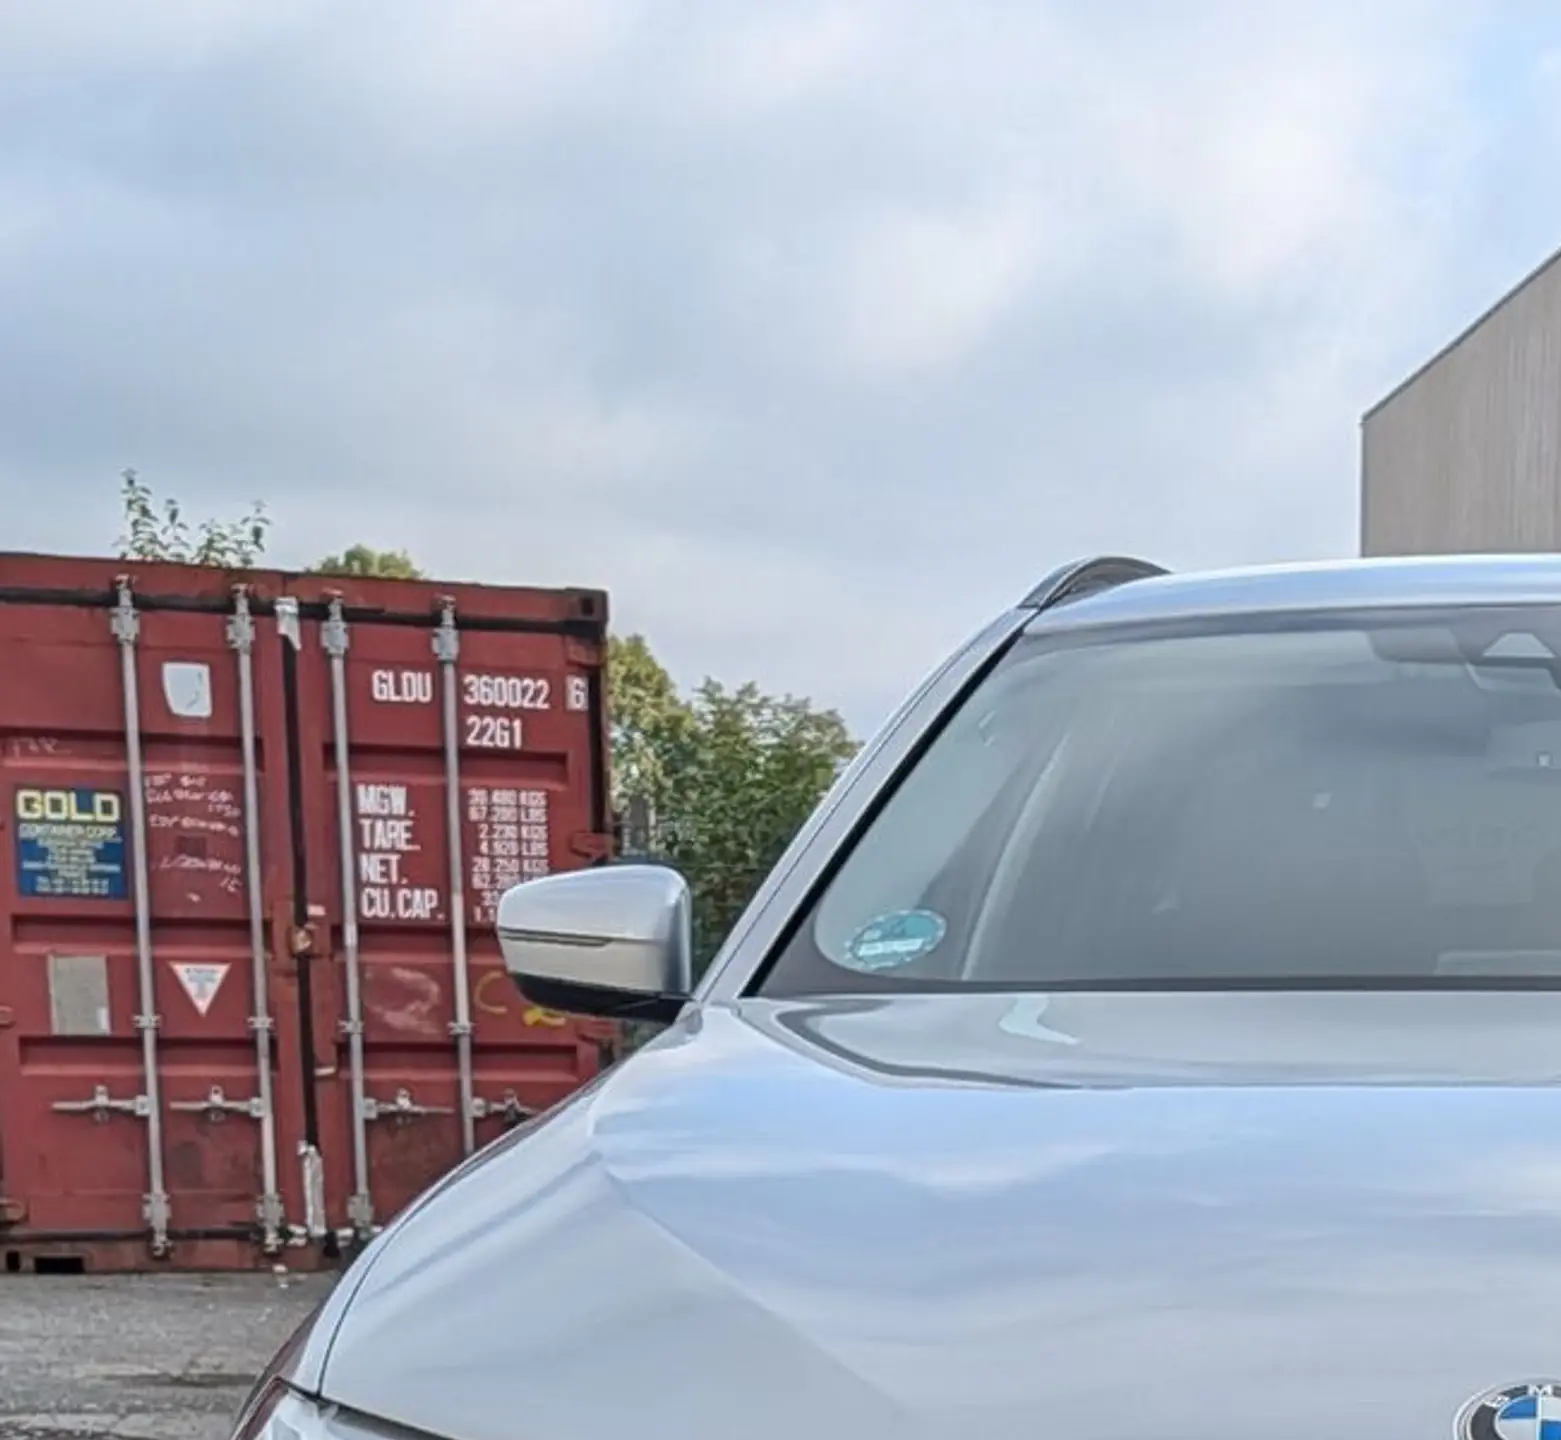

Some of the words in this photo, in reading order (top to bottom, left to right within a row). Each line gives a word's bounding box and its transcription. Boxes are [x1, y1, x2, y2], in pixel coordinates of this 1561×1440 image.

[372, 669, 432, 703] GLDU
[463, 674, 550, 709] 360022
[570, 676, 588, 710] 6
[466, 715, 522, 749] 22G1
[16, 789, 120, 822] GOLD
[357, 784, 416, 818] MGW.
[360, 853, 409, 885] NET.
